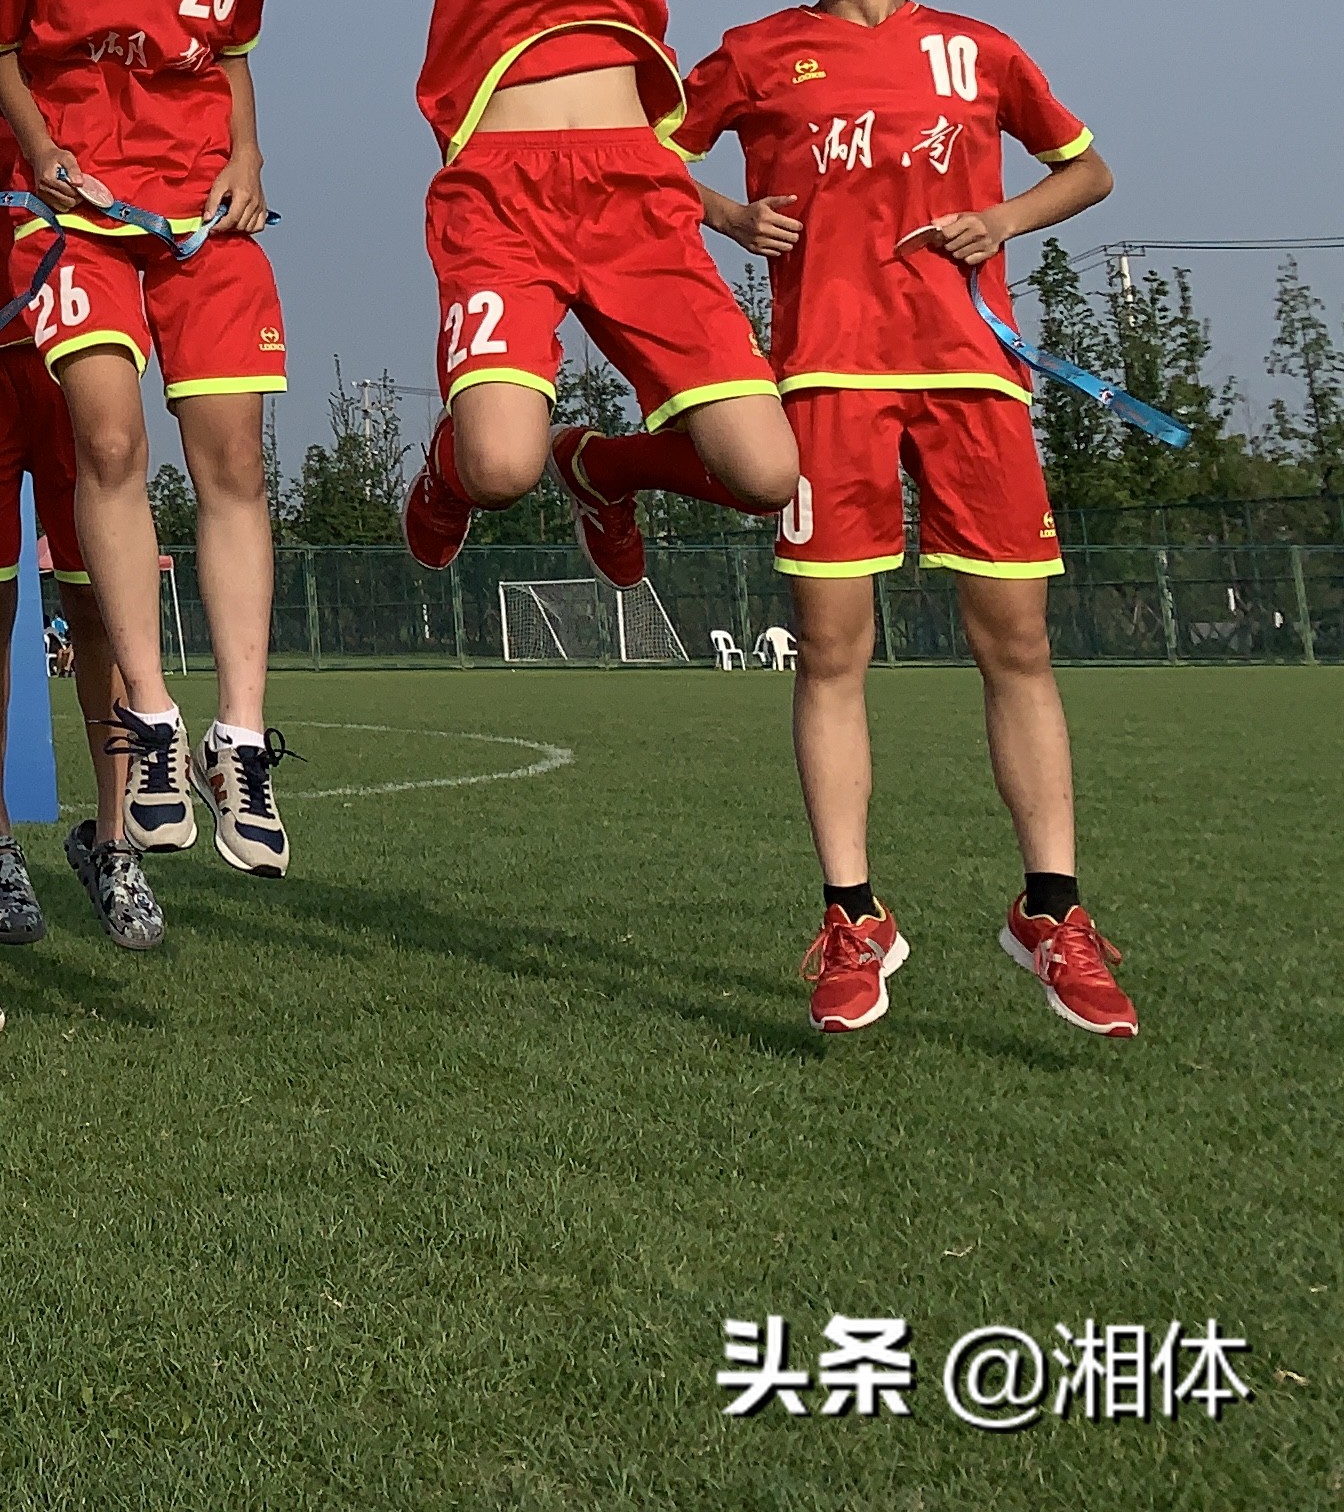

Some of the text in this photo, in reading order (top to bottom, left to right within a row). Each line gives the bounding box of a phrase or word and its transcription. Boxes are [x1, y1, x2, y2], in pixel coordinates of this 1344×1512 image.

[919, 33, 980, 102] 10
[807, 109, 964, 175] 湖南
[26, 265, 91, 348] 26
[445, 290, 509, 373] 22
[775, 474, 814, 545] 0
